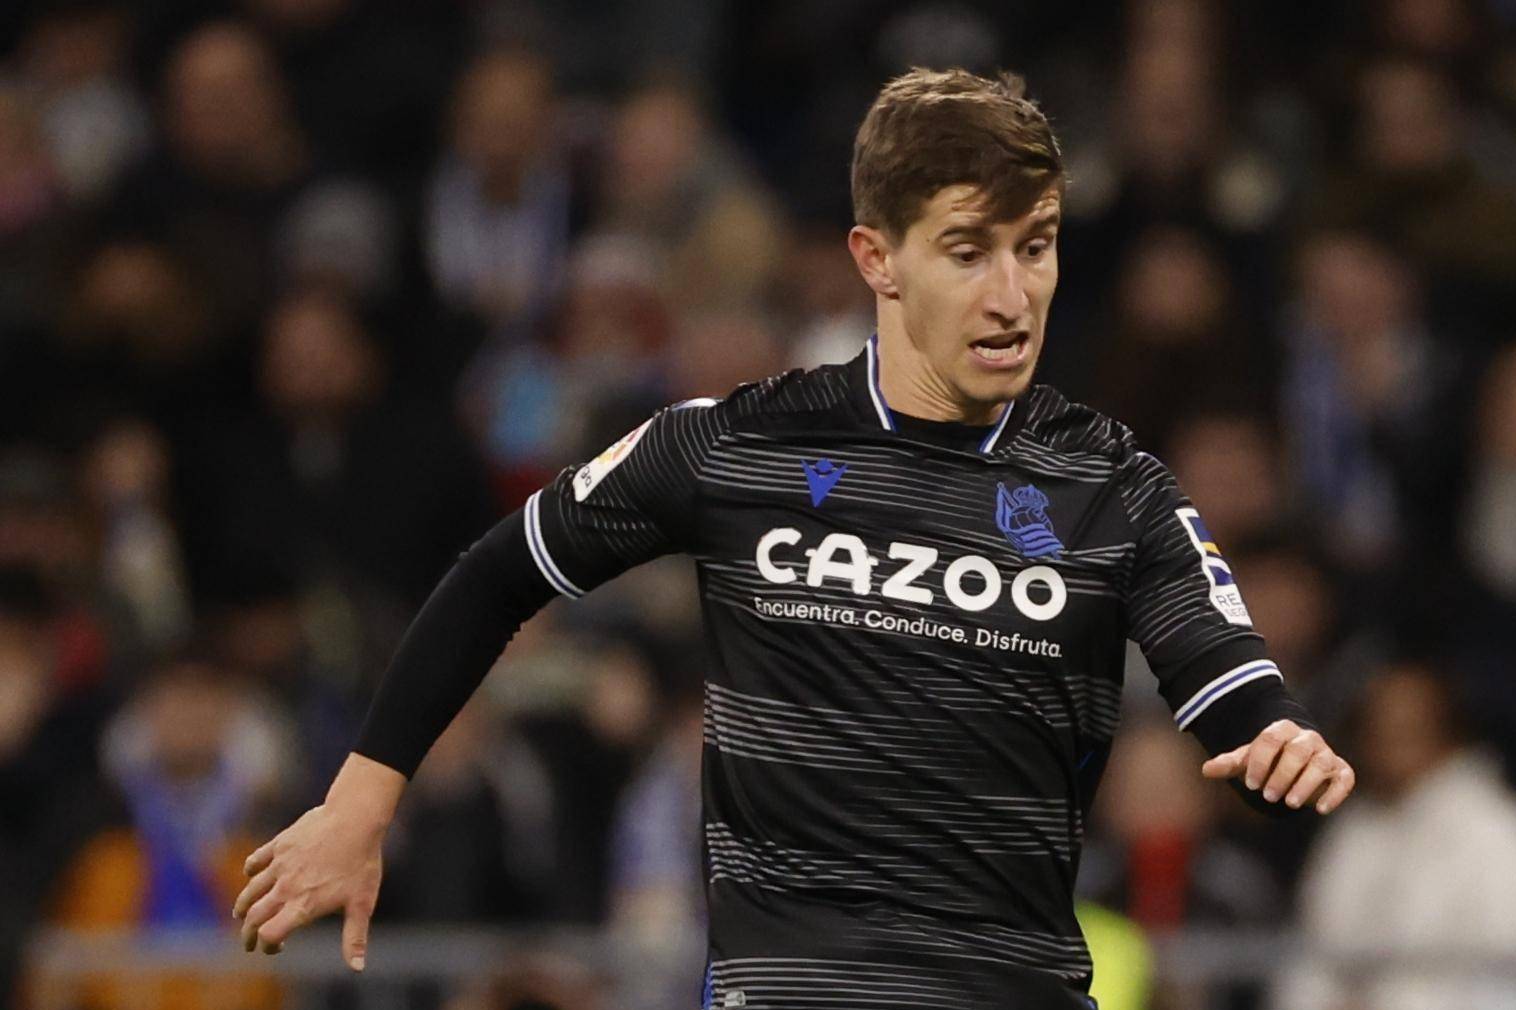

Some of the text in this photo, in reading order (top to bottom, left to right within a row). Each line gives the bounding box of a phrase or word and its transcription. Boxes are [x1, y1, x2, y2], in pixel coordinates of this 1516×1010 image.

[755, 527, 1068, 622] CAZOO
[755, 597, 1063, 659] Encuentra. Conduce. Disfruta.
